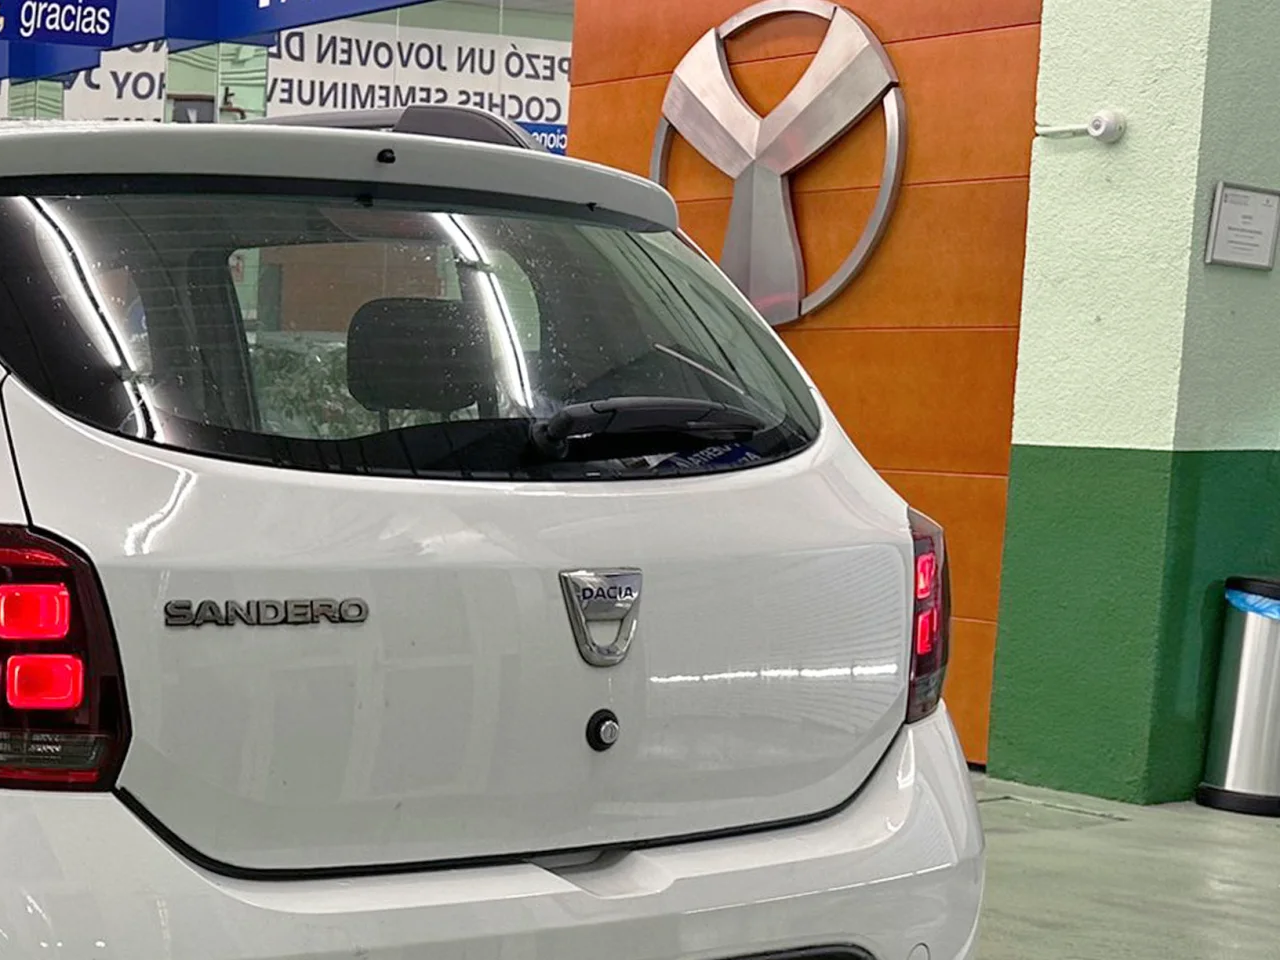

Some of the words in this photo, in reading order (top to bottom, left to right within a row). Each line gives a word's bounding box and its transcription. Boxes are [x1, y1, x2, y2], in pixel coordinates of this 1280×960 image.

[20, 0, 110, 37] gracias
[581, 585, 634, 601] DACIA
[164, 597, 370, 628] SANDERO
